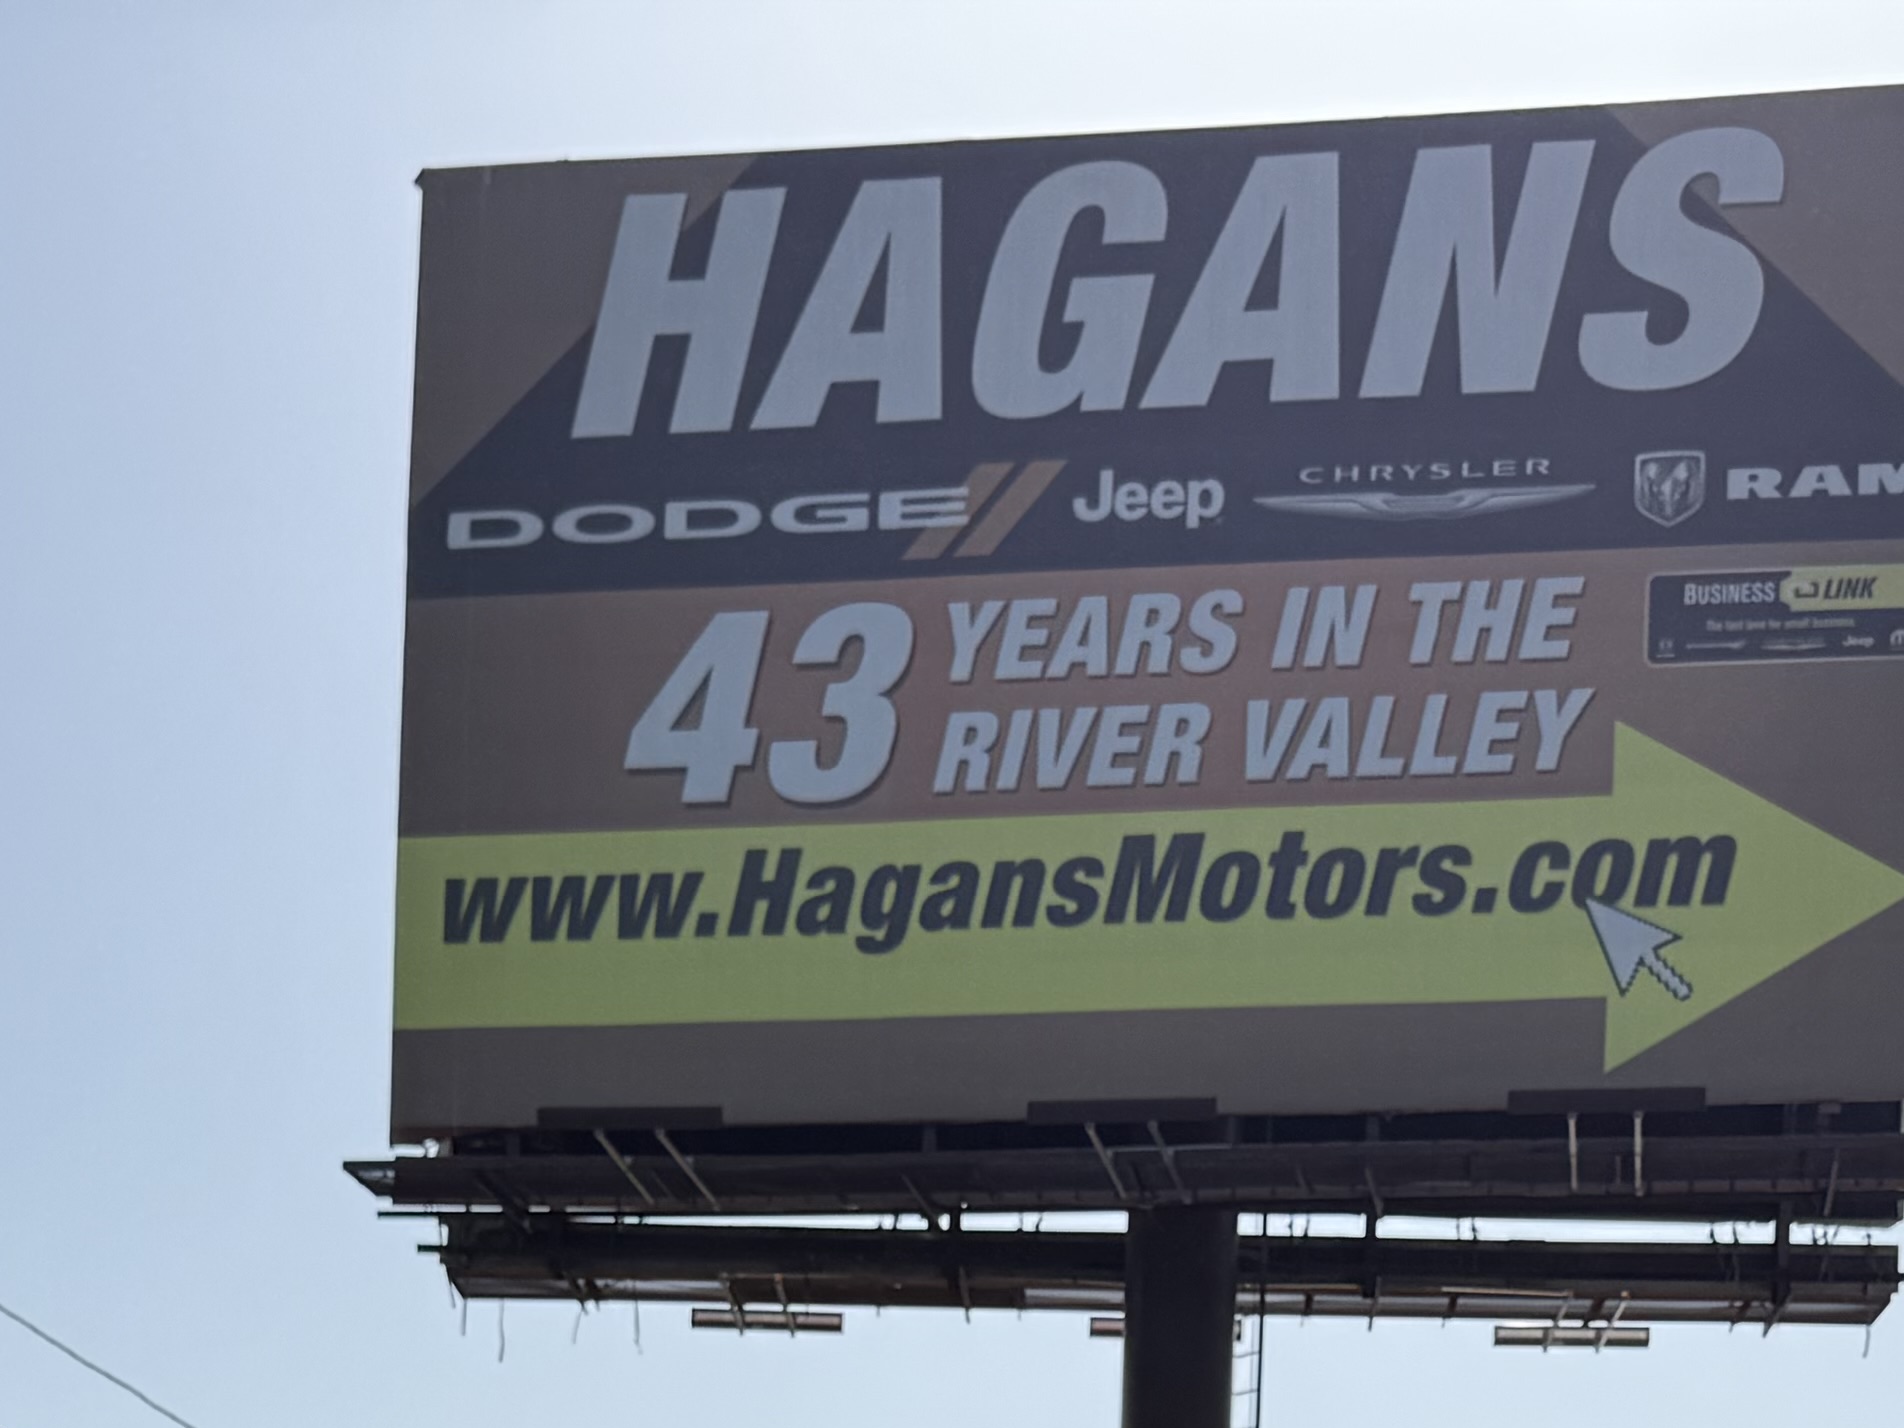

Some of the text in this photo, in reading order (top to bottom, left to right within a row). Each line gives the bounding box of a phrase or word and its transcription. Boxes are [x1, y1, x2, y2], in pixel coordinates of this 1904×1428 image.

[570, 127, 1785, 439] HAGANS
[447, 486, 970, 550] DODGE
[1072, 468, 1225, 529] Jeep
[1299, 458, 1550, 484] CHRYSLER
[947, 576, 1586, 684] YEARS IN THE
[1823, 576, 1878, 601] LINK
[624, 602, 915, 806] 43
[932, 687, 1597, 793] RIVER VALLEY
[443, 831, 1737, 955] www.HagansMotors.com
